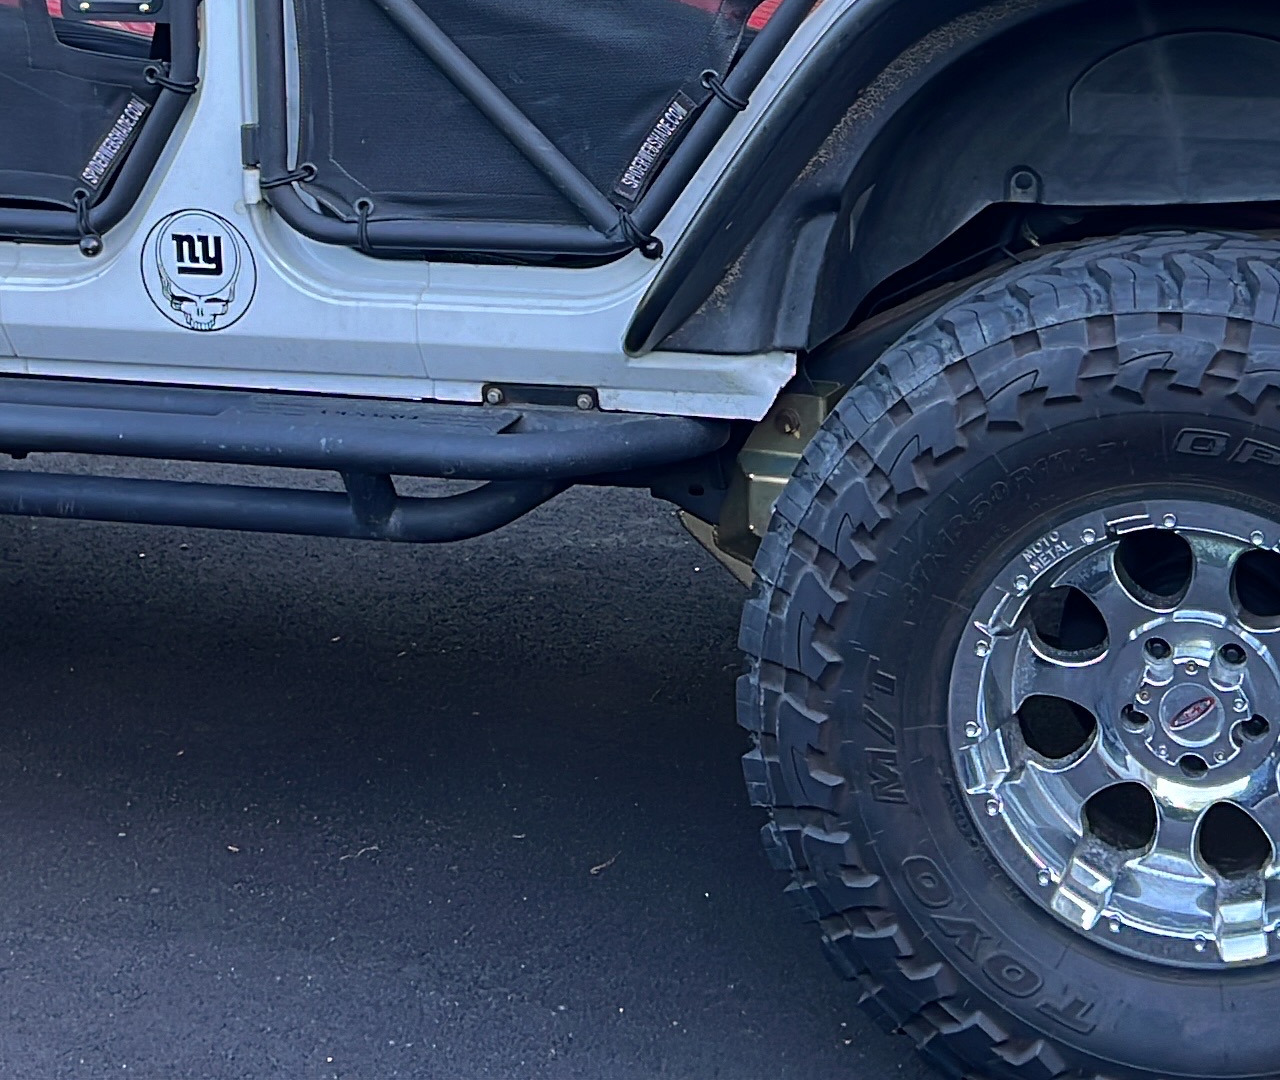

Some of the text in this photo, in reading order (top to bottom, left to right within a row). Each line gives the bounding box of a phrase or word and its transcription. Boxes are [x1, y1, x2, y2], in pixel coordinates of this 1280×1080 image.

[81, 98, 148, 187] SPIDERWEBSHADE.COM
[621, 100, 688, 190] SPIDERWEBSHADE.COM
[1021, 529, 1061, 563] MOTO
[1028, 540, 1074, 575] METAL
[901, 854, 1098, 1035] TOYO
